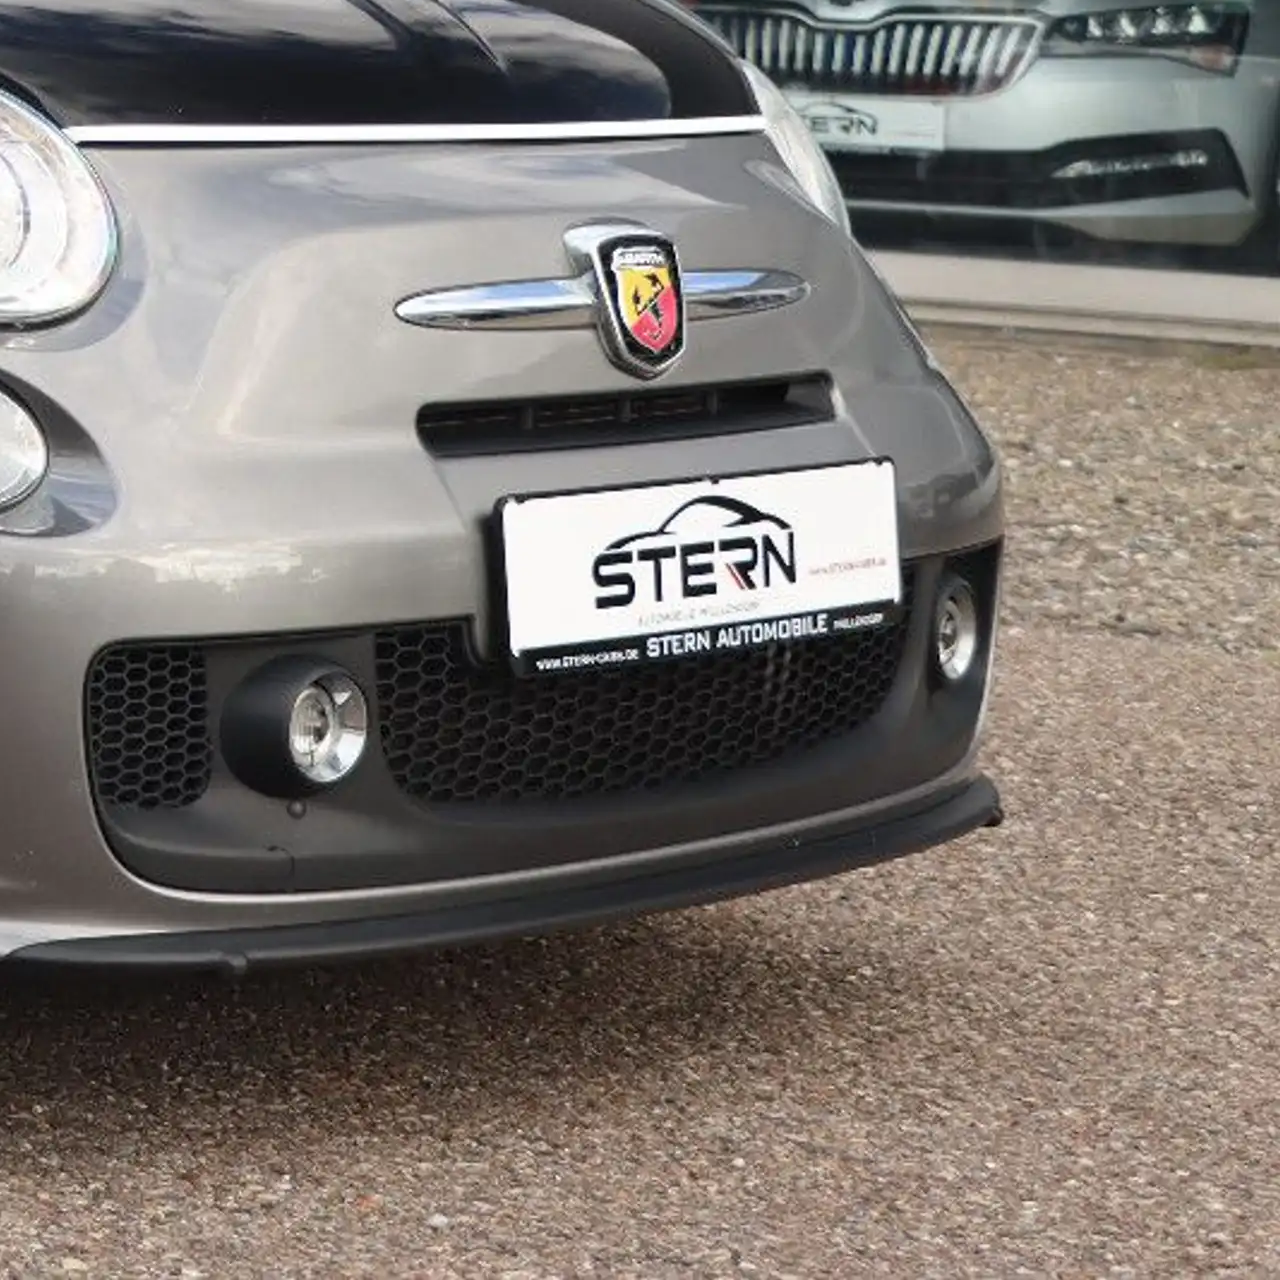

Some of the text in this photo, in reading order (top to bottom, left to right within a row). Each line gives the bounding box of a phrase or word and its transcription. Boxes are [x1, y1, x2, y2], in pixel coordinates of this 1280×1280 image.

[591, 531, 797, 610] STERN
[646, 630, 711, 658] STERN
[716, 613, 828, 648] AUTOMOBILE
